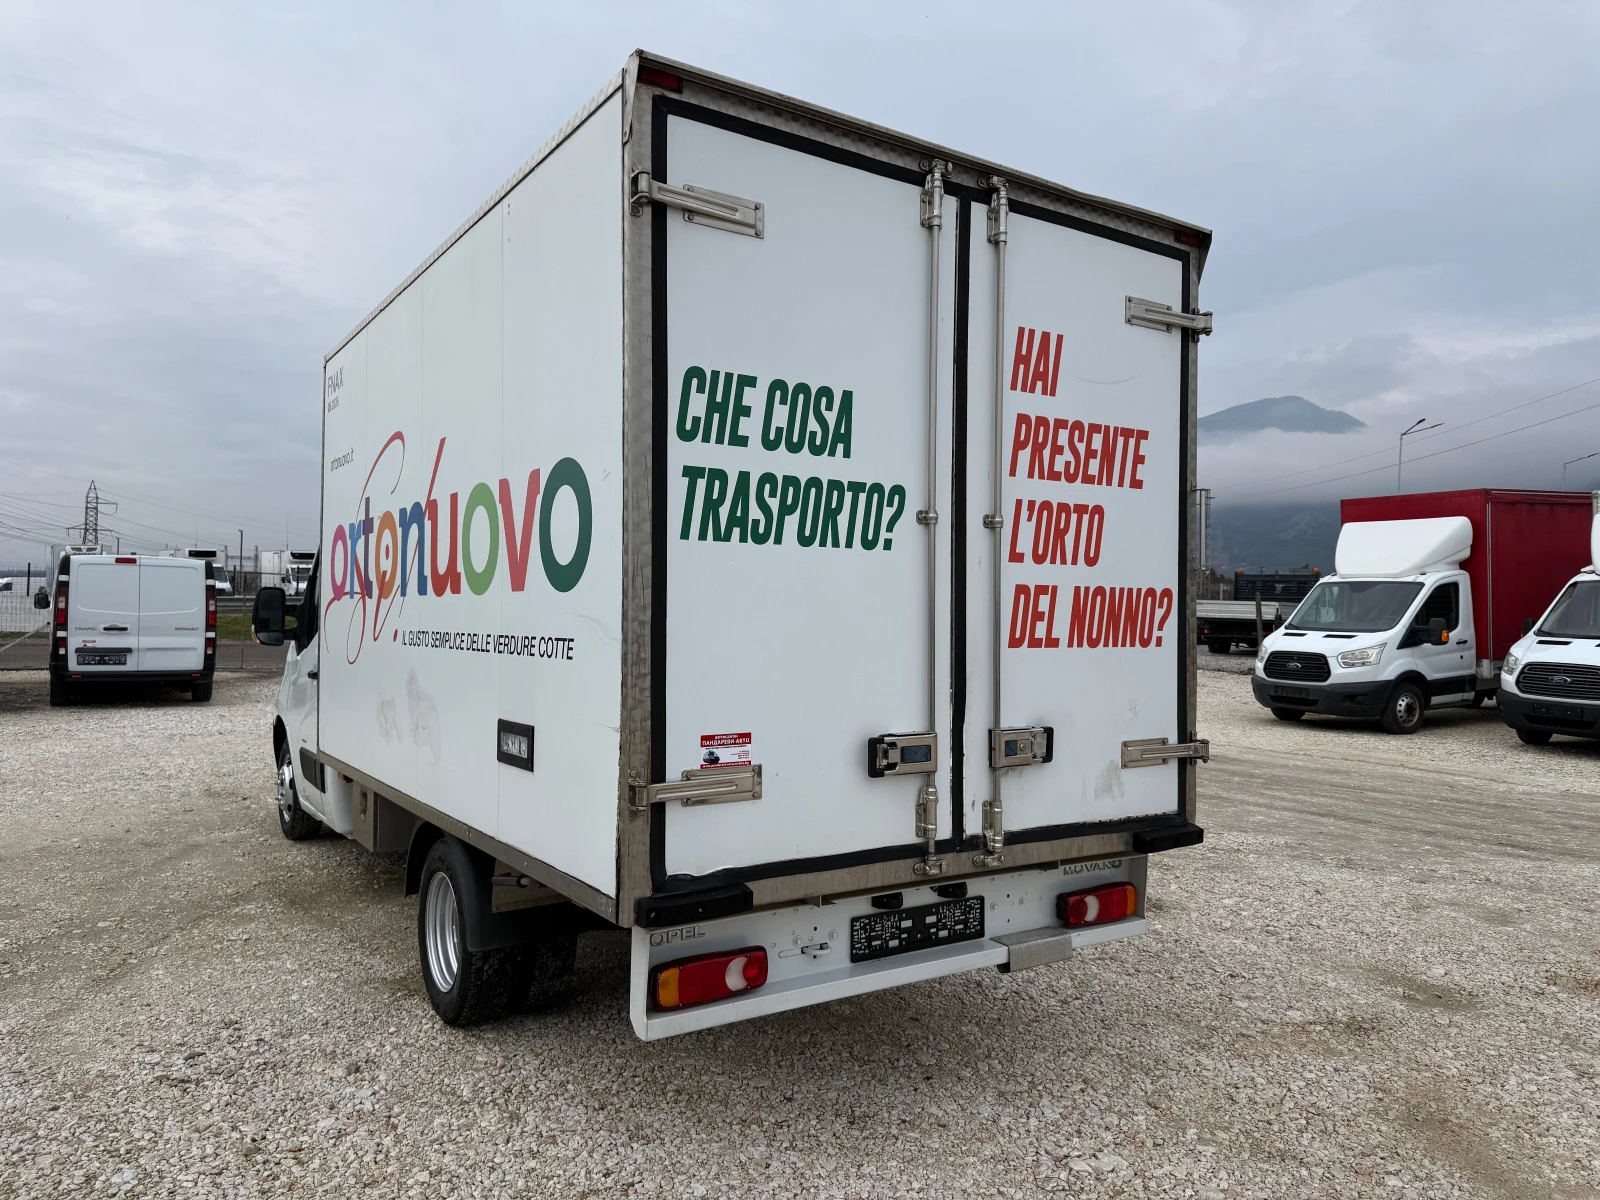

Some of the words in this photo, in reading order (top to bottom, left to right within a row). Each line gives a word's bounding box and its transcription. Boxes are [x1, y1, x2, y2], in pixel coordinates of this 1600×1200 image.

[327, 365, 344, 398] FNAX
[1010, 326, 1064, 397] HAI
[676, 365, 758, 448] CHE
[761, 379, 853, 459] COSA
[1009, 413, 1149, 490] PRESENTE
[330, 456, 593, 602] ortonuovo
[679, 465, 906, 551] TRASPORTO?
[1008, 499, 1105, 567] L'ORTO
[408, 630, 430, 648] GUSTO
[430, 631, 466, 651] SEMPLICE
[466, 633, 492, 653] DELLE
[493, 634, 537, 657] VERDURE
[538, 636, 575, 661] COTTE
[1007, 584, 1060, 649] DEL
[1067, 586, 1173, 648] NONNO?
[1063, 859, 1122, 876] MOVANO
[649, 925, 706, 947] OPEL
